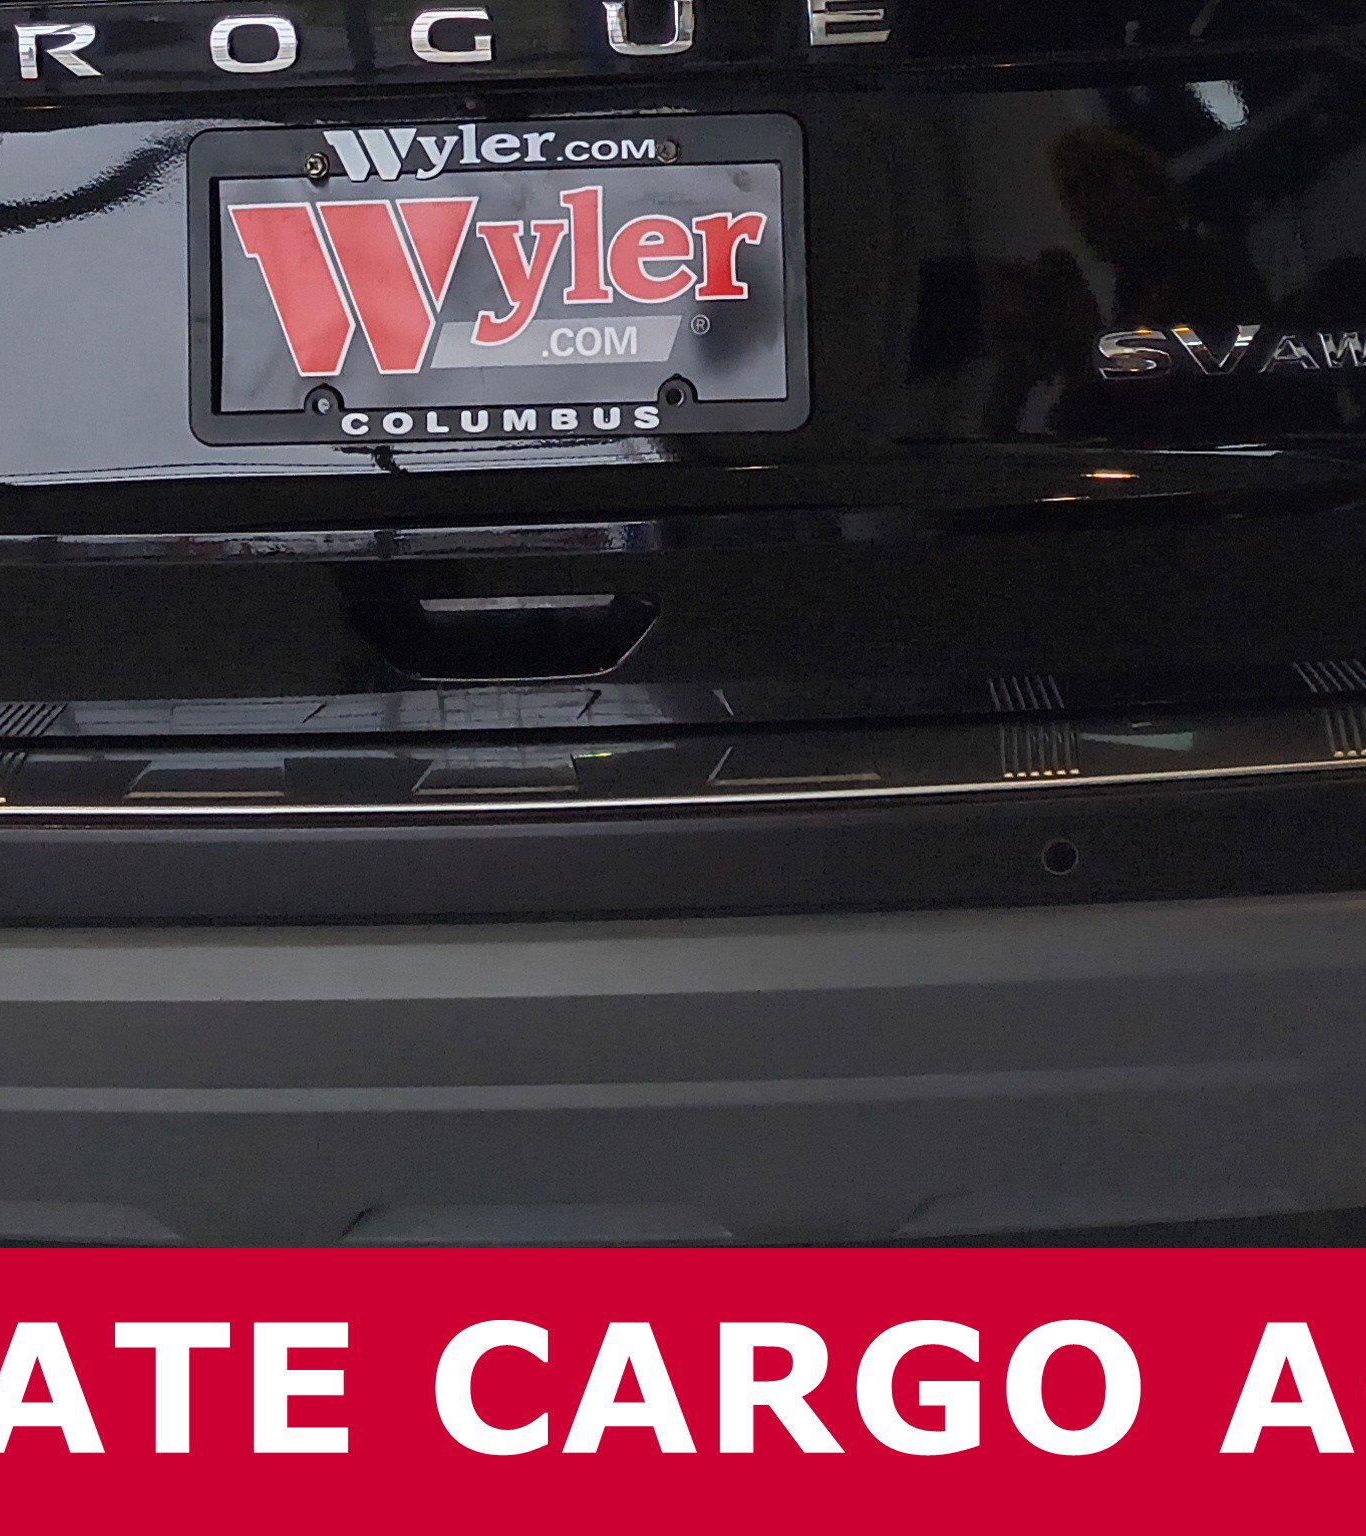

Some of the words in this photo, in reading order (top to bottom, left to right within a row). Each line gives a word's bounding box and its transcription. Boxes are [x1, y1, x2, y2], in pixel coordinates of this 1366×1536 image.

[227, 185, 768, 378] Wyler
[541, 325, 639, 359] .COM
[340, 404, 661, 437] COLUMBUS
